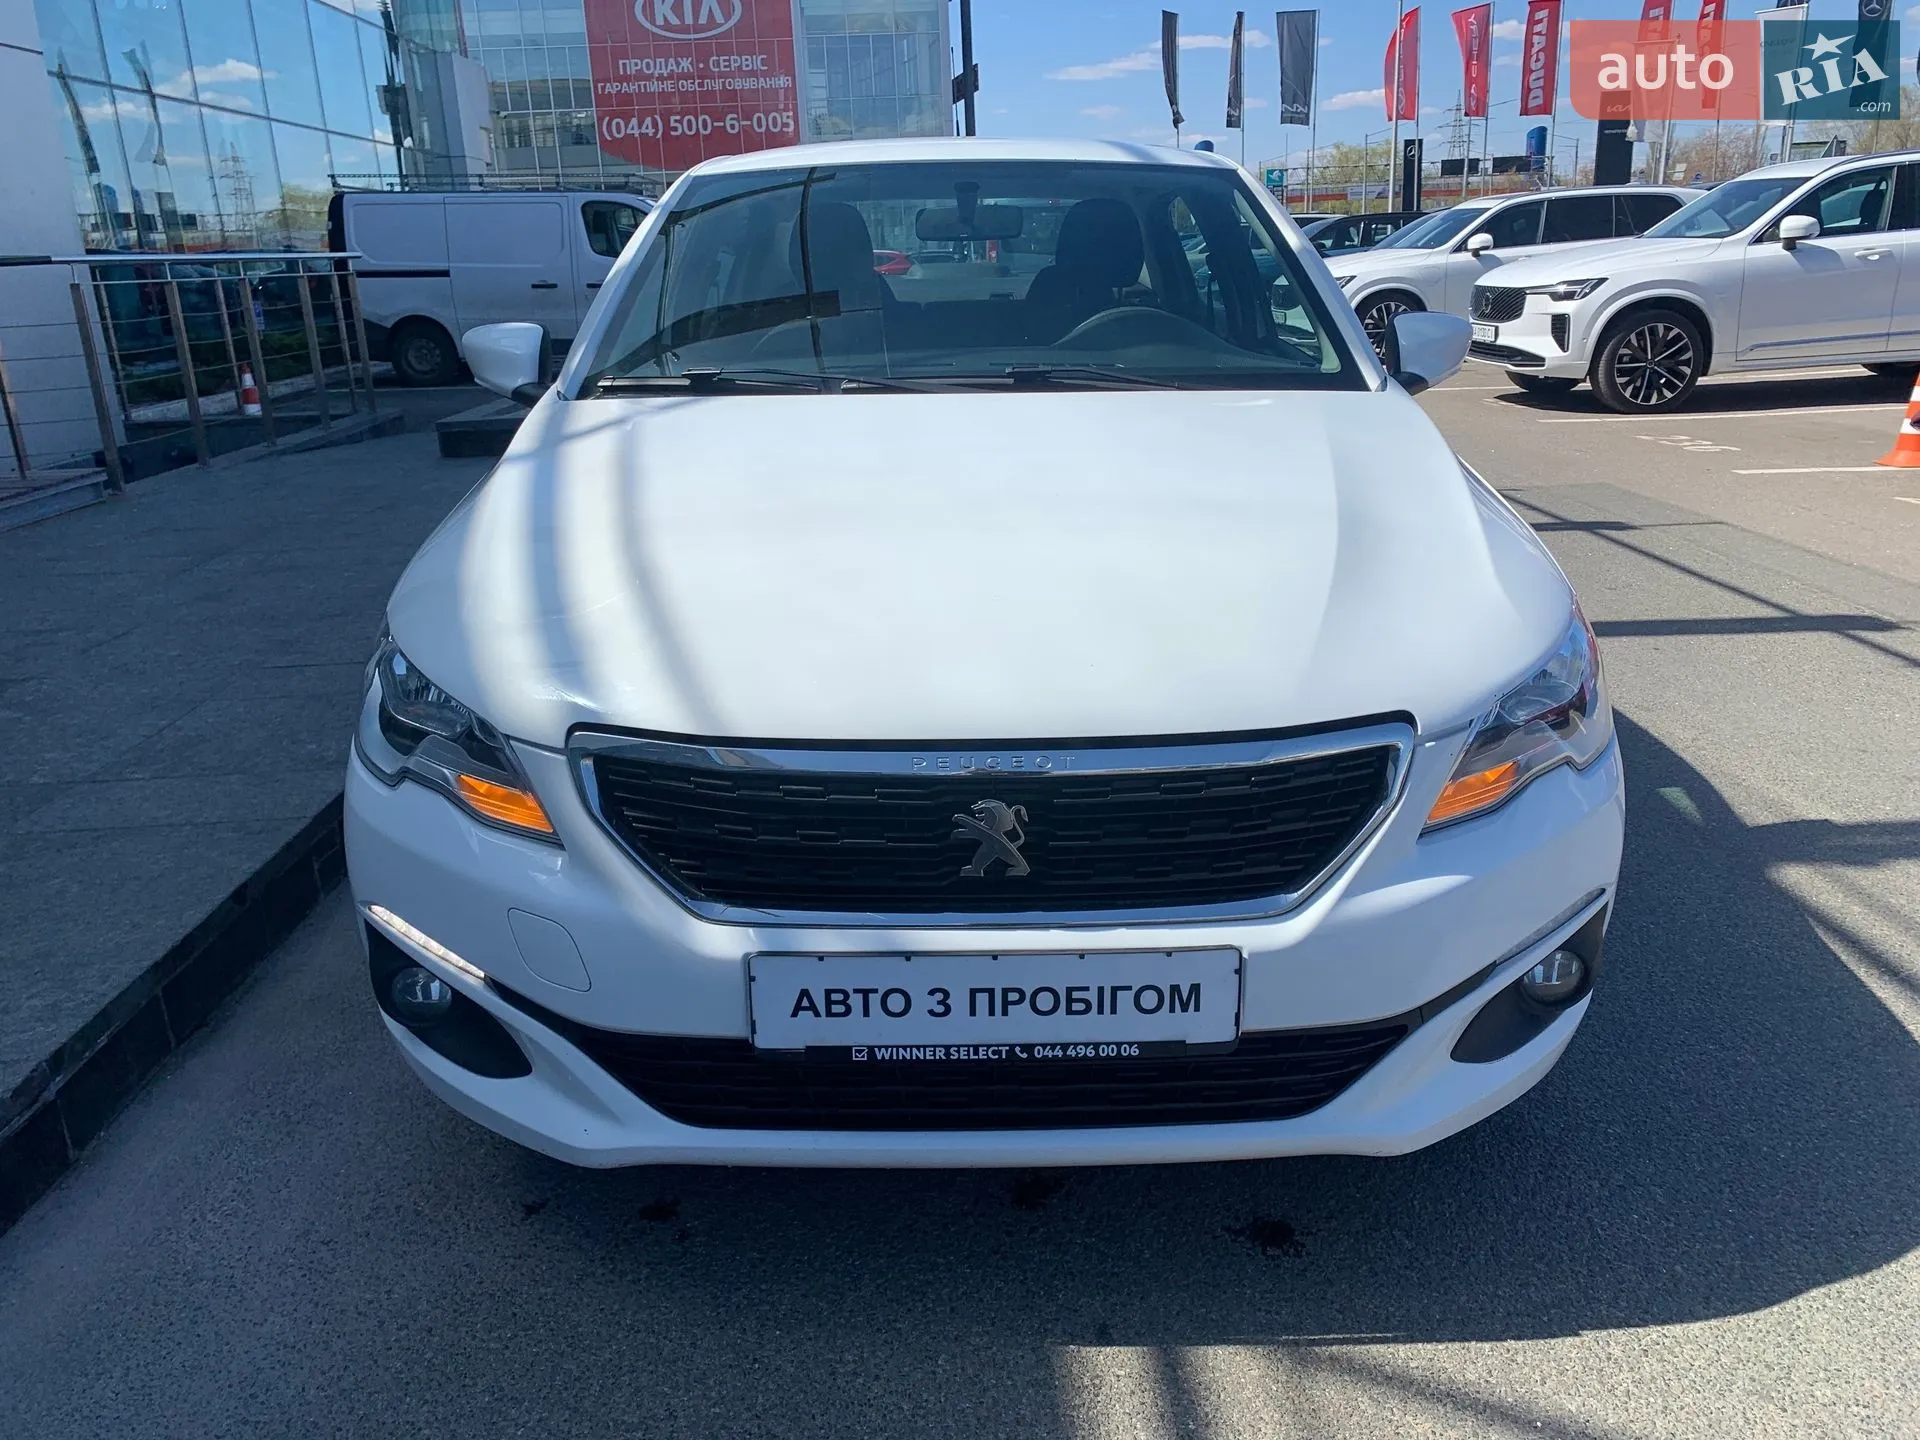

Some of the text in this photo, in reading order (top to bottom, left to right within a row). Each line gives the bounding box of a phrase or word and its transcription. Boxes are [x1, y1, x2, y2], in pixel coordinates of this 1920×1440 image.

[654, 0, 725, 25] KIA
[618, 55, 769, 76] ПРОДАЖ СЕРВІС
[597, 76, 792, 94] ГАРАНТІЙНЕ ОБСЛУГОВУВАННЯ
[602, 110, 795, 141] (044) 500-6-005
[911, 755, 1076, 771] PEUGEOT
[790, 987, 913, 1018] АВТО
[968, 982, 1202, 1018] ПРОБІГОМ
[874, 1043, 1140, 1060] WINNER SELECT 044 496 00 06
